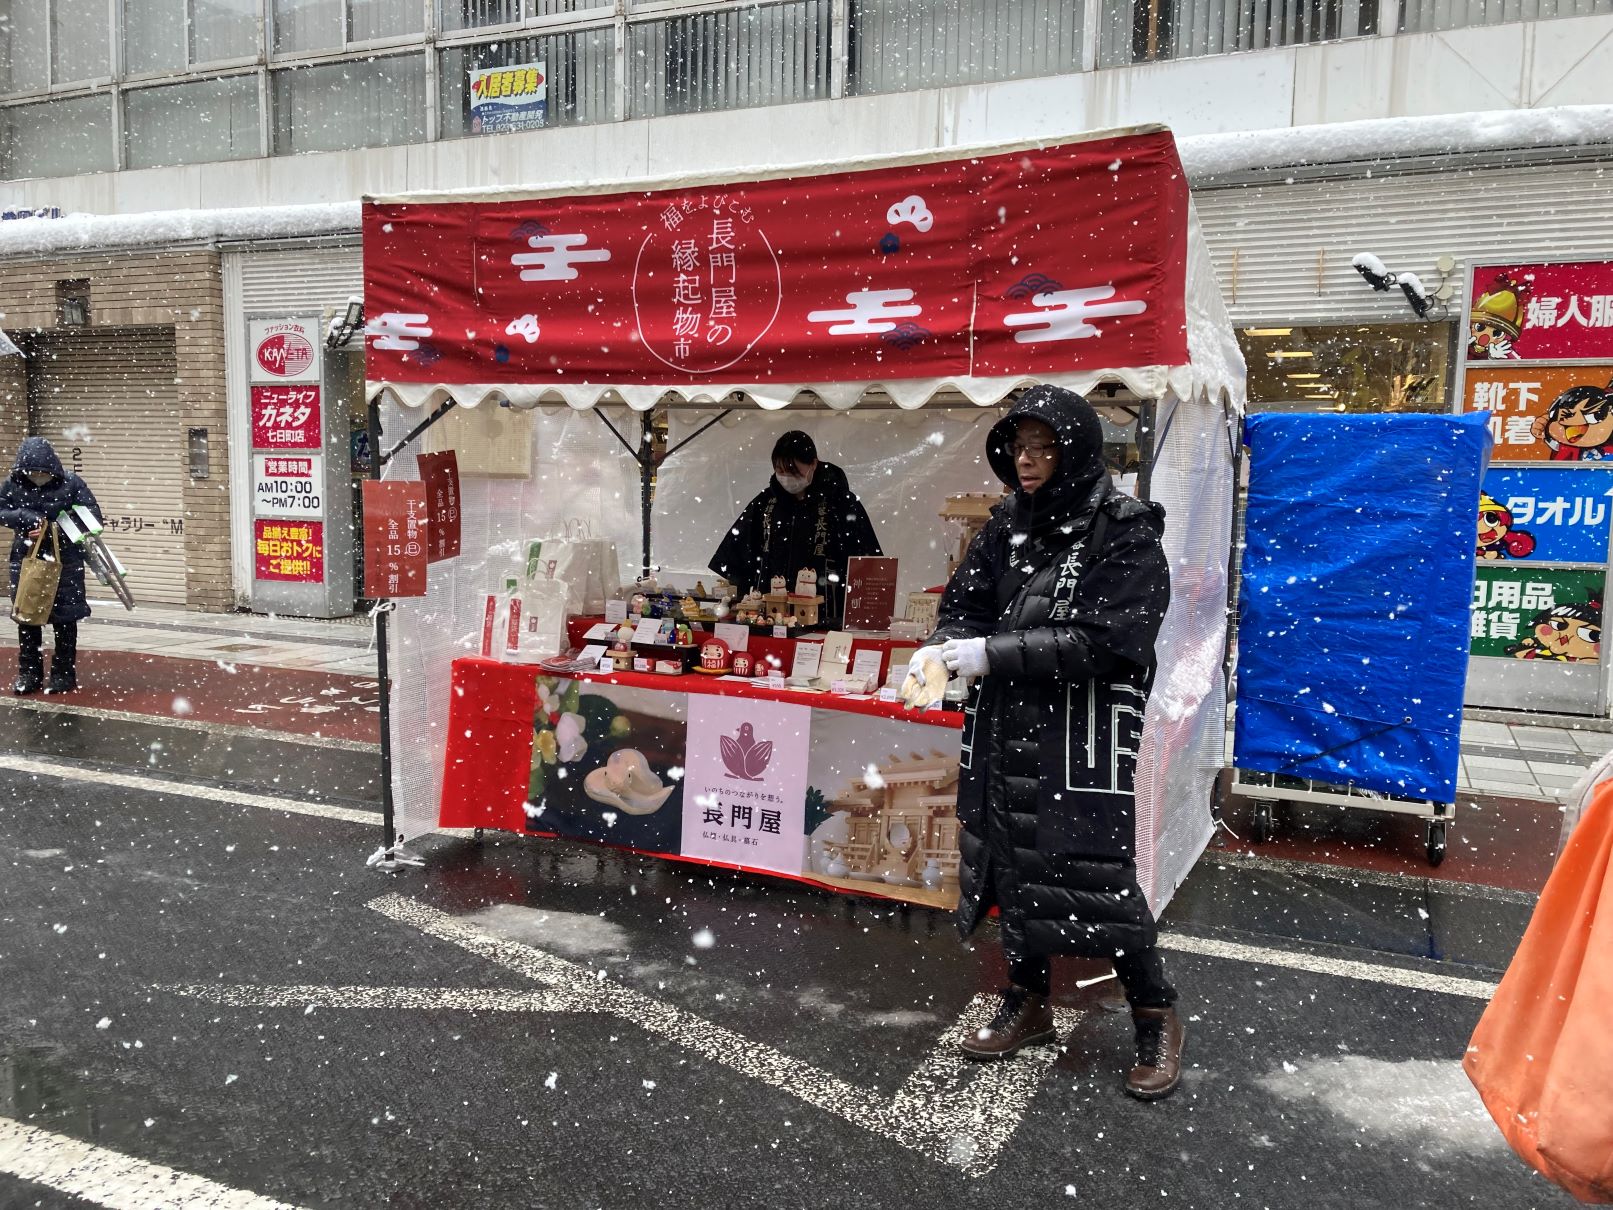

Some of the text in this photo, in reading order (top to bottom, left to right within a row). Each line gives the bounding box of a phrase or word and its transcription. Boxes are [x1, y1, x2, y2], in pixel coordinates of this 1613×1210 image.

[477, 68, 539, 99] 入居者募集
[706, 217, 737, 345] 長門屋の
[671, 238, 701, 359] 縁起物市
[261, 391, 316, 403] ニューライフ
[1472, 381, 1542, 411] 靴下
[259, 405, 312, 428] カネタ
[267, 429, 305, 443] 七日町店
[267, 459, 309, 474] 営業時間
[1505, 496, 1605, 526] タオル
[257, 540, 322, 558] 毎日おトクに
[1048, 552, 1083, 621] 長門屋
[702, 802, 782, 835] 長門屋
